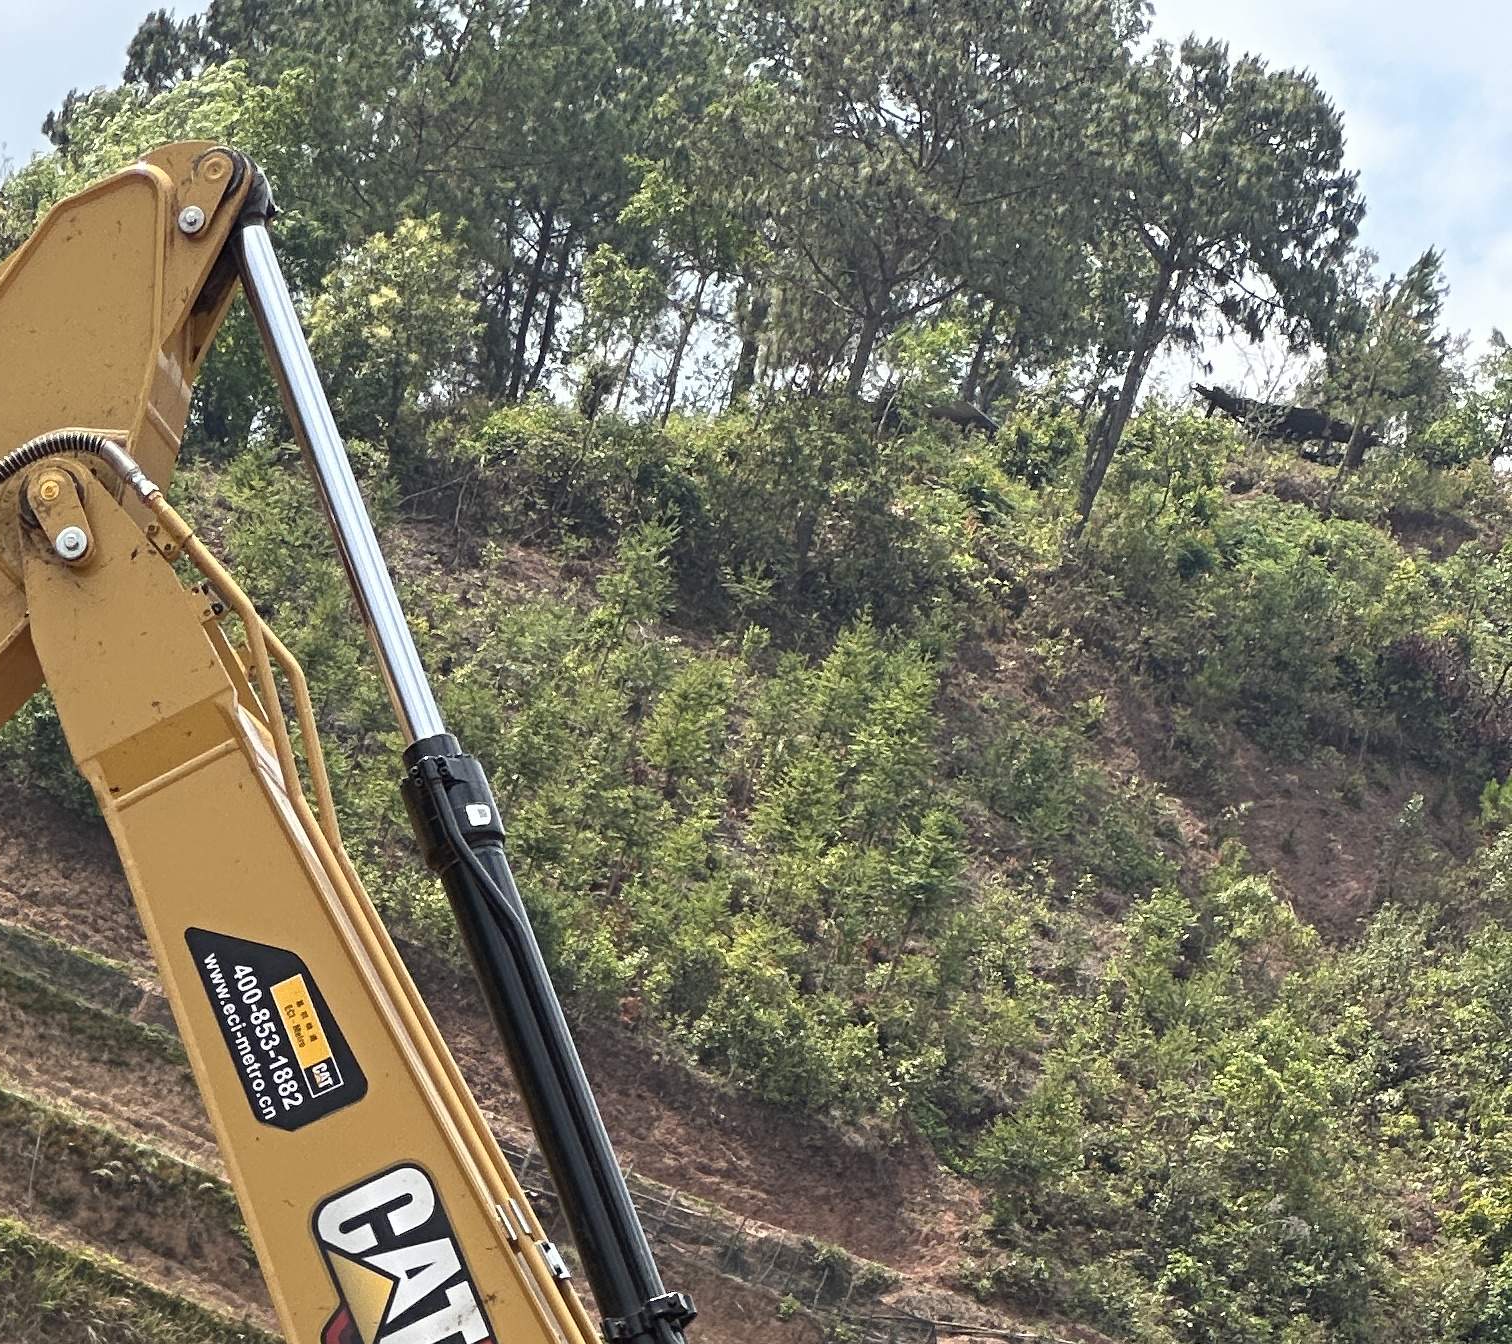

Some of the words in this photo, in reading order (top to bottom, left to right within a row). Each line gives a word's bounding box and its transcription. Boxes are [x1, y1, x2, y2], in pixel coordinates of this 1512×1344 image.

[204, 953, 277, 1120] www.eci-metro.cn
[234, 964, 304, 1111] 400-853-1882
[312, 1062, 334, 1088] CAT
